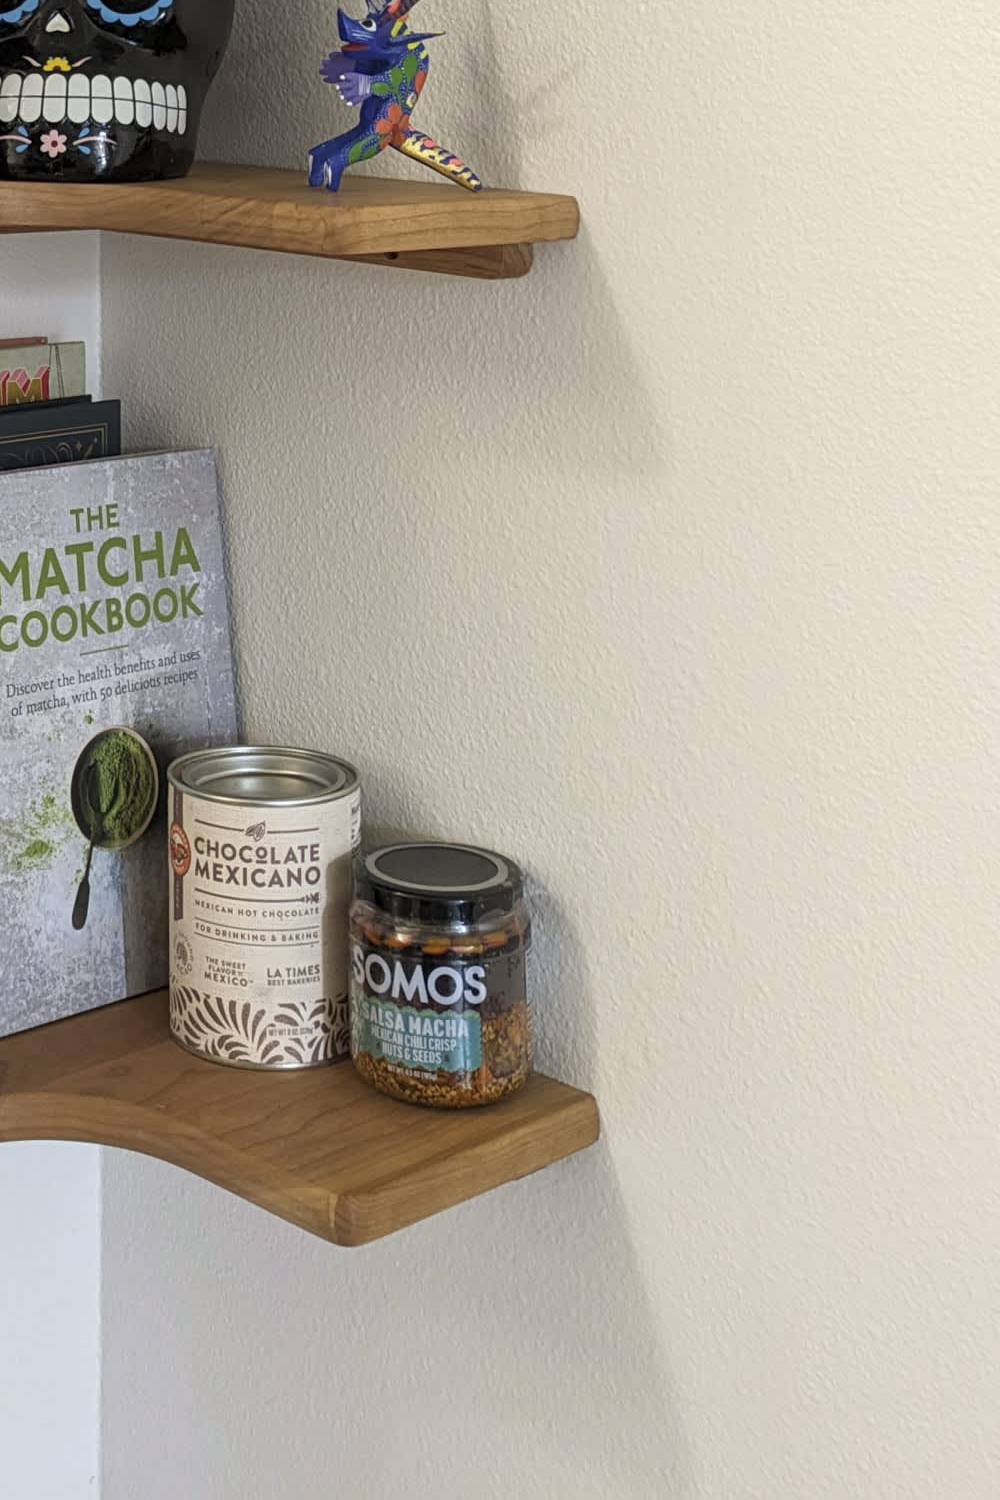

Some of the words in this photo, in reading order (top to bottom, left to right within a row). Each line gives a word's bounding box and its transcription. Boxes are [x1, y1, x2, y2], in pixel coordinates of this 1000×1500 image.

[70, 503, 120, 532] THE
[6, 679, 54, 698] Discover
[57, 673, 75, 688] the
[77, 665, 112, 684] health
[114, 658, 156, 676] benefits
[158, 652, 177, 667] and
[180, 650, 200, 663] uses
[11, 702, 23, 717] of
[26, 696, 70, 715] matcha,
[72, 690, 97, 705] with
[100, 687, 112, 702] 50
[115, 677, 161, 696] delicious
[164, 669, 198, 689] recipes
[194, 859, 321, 888] MEXICANO
[195, 899, 233, 914] MEXICAN
[262, 907, 320, 918] CHOCOLATE
[195, 923, 211, 934] FOR
[215, 928, 266, 942] DRINKING
[281, 931, 319, 942] BAKING
[206, 956, 219, 965] THE
[222, 960, 246, 970] SWEET
[208, 964, 237, 976] FLAVOR
[267, 968, 282, 978] LA
[286, 964, 320, 977] TIMES
[352, 945, 488, 1005] SOMOS
[361, 1001, 405, 1032] SALSA
[408, 1016, 470, 1037] MACHA
[371, 1023, 403, 1045] MEXICAN
[405, 1034, 427, 1050] CHILI
[429, 1037, 457, 1052] CRISP
[382, 1041, 403, 1058] NUTS
[412, 1050, 442, 1064] SEEDS
